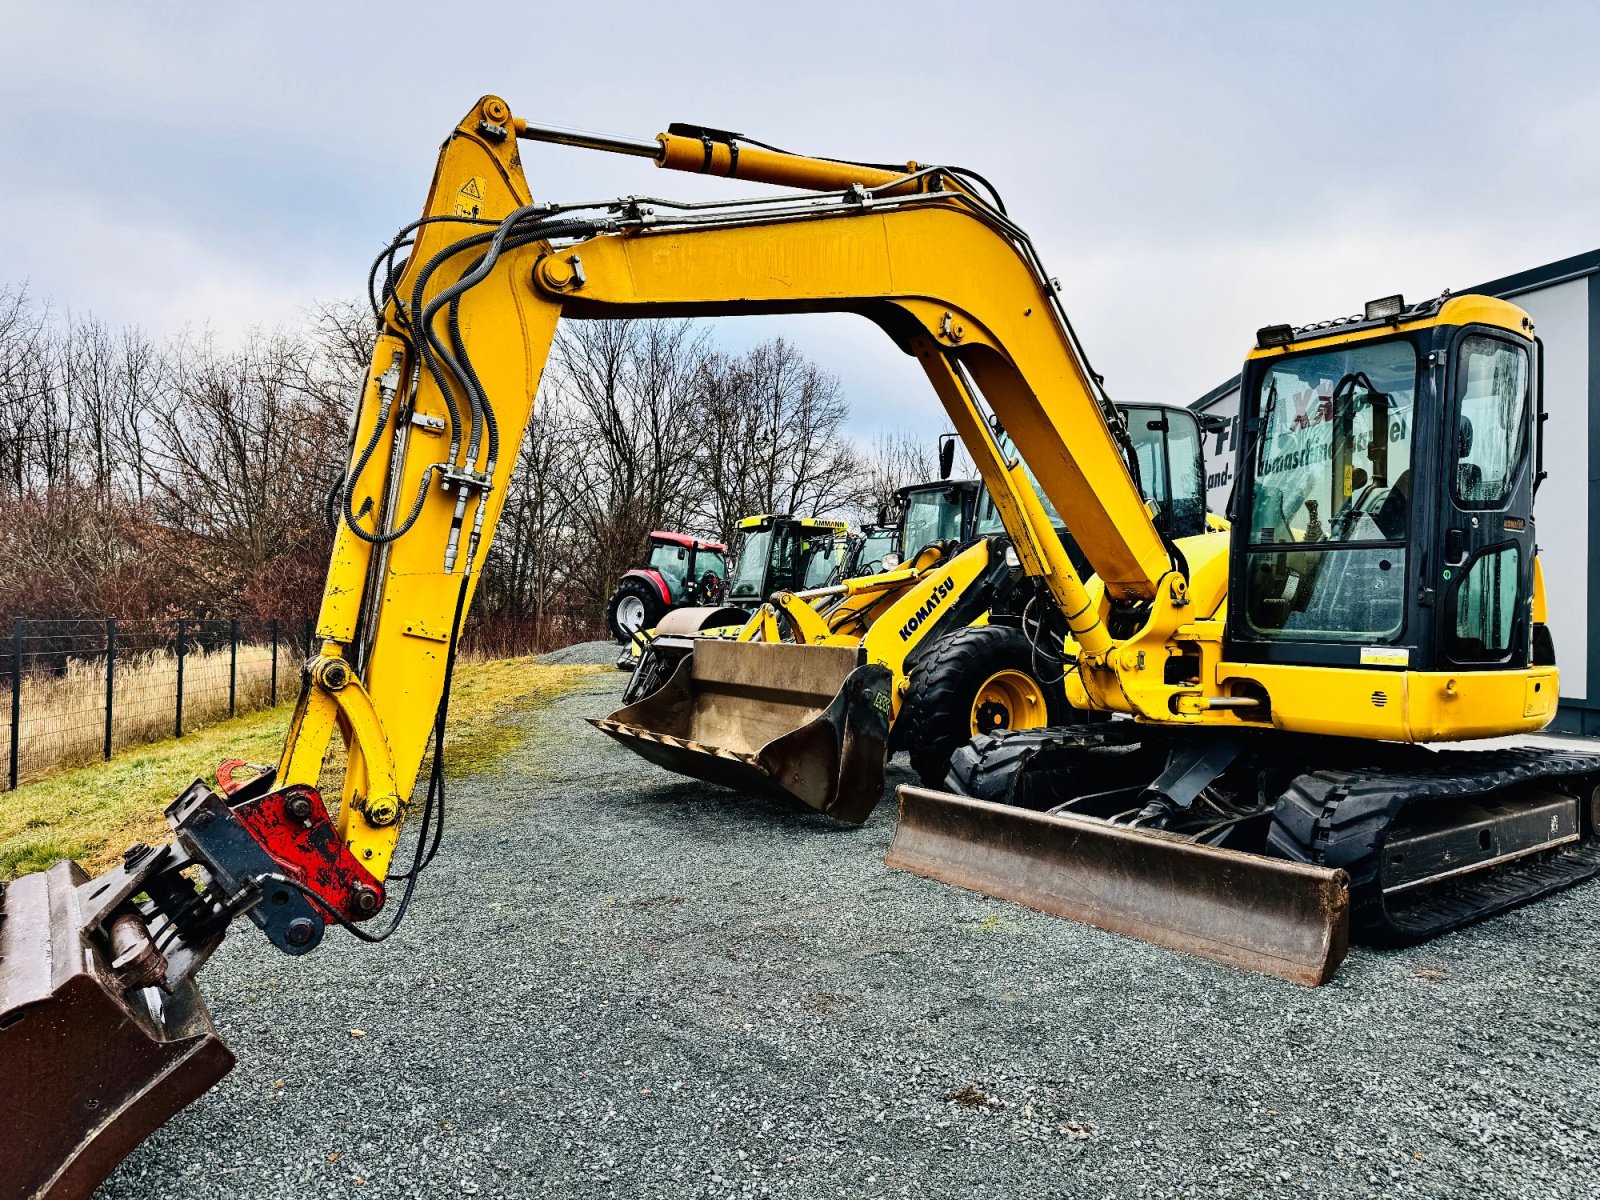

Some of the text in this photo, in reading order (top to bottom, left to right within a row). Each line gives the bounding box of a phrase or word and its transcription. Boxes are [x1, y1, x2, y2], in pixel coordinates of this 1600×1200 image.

[1206, 461, 1233, 491] and-
[814, 519, 845, 528] AMMANN
[898, 576, 955, 642] KOMATSU
